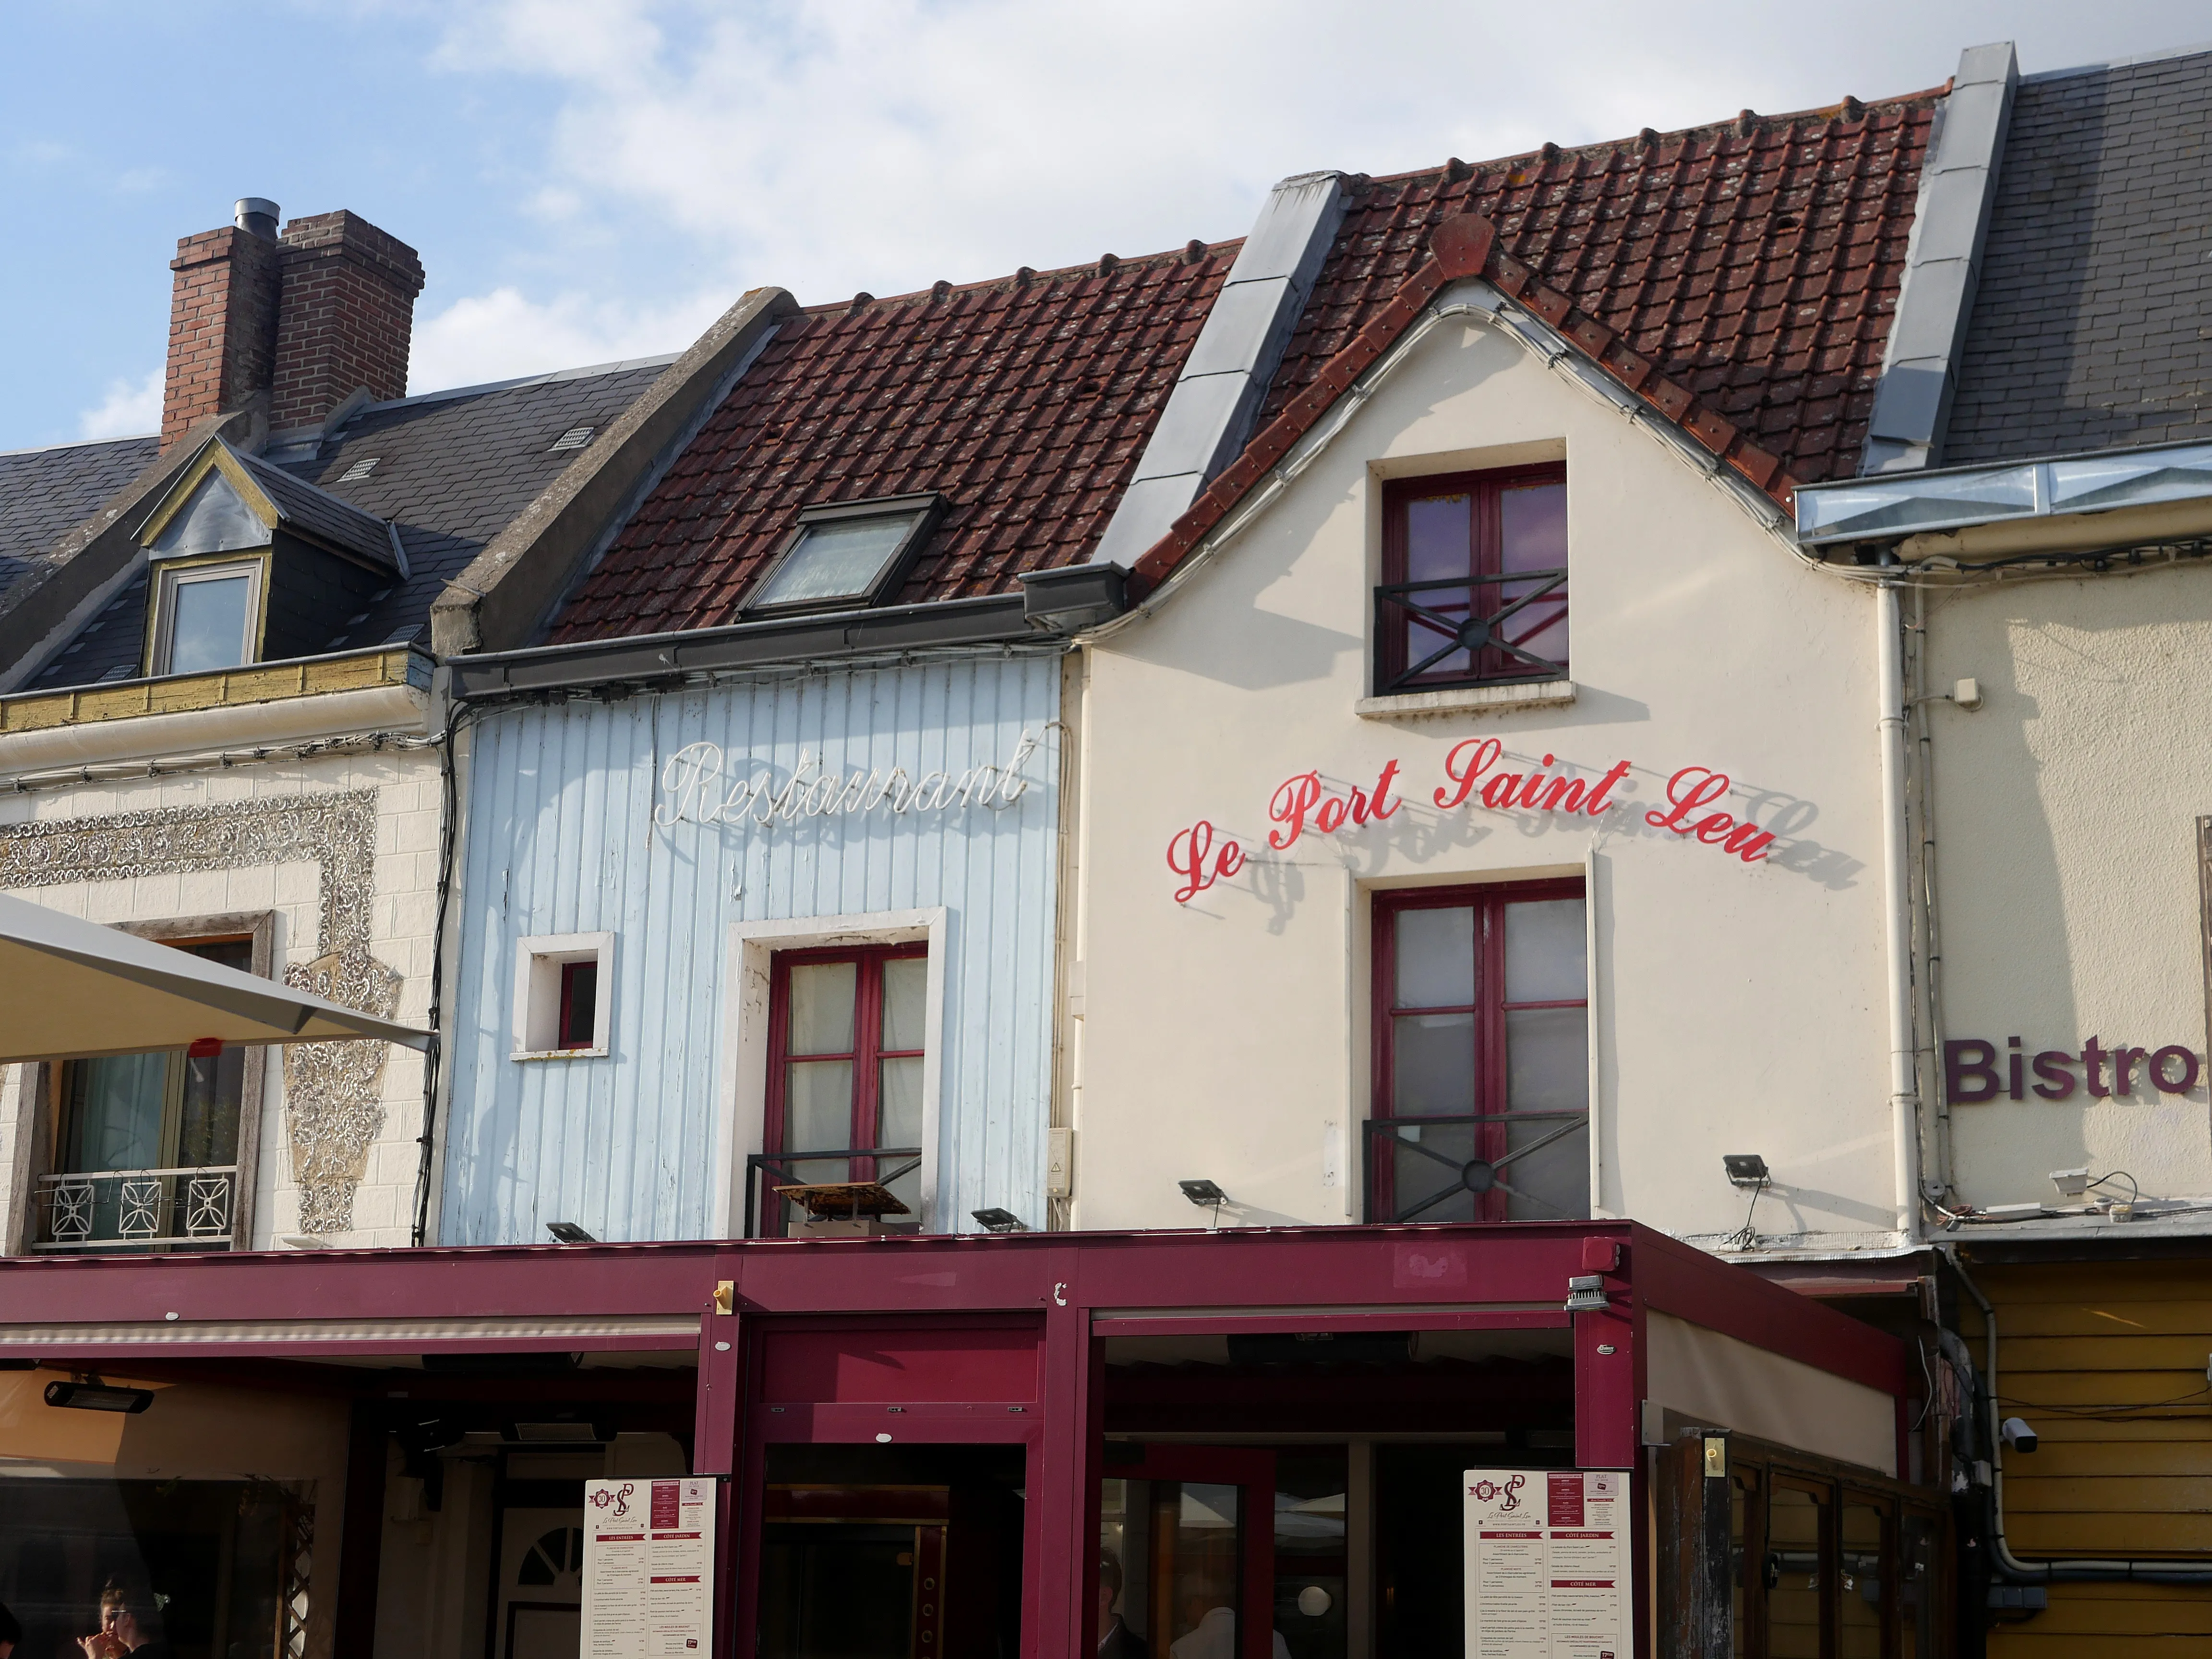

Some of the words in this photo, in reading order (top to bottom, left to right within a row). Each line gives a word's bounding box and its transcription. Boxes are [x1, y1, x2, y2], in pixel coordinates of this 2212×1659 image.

[655, 728, 1028, 826] Restaurant
[1167, 820, 1245, 903] Le
[1269, 759, 1402, 850] Port
[1434, 738, 1631, 816] Saint
[1645, 766, 1776, 862] Leu
[1945, 1034, 2200, 1103] Bistro
[1481, 1487, 1489, 1495] 30
